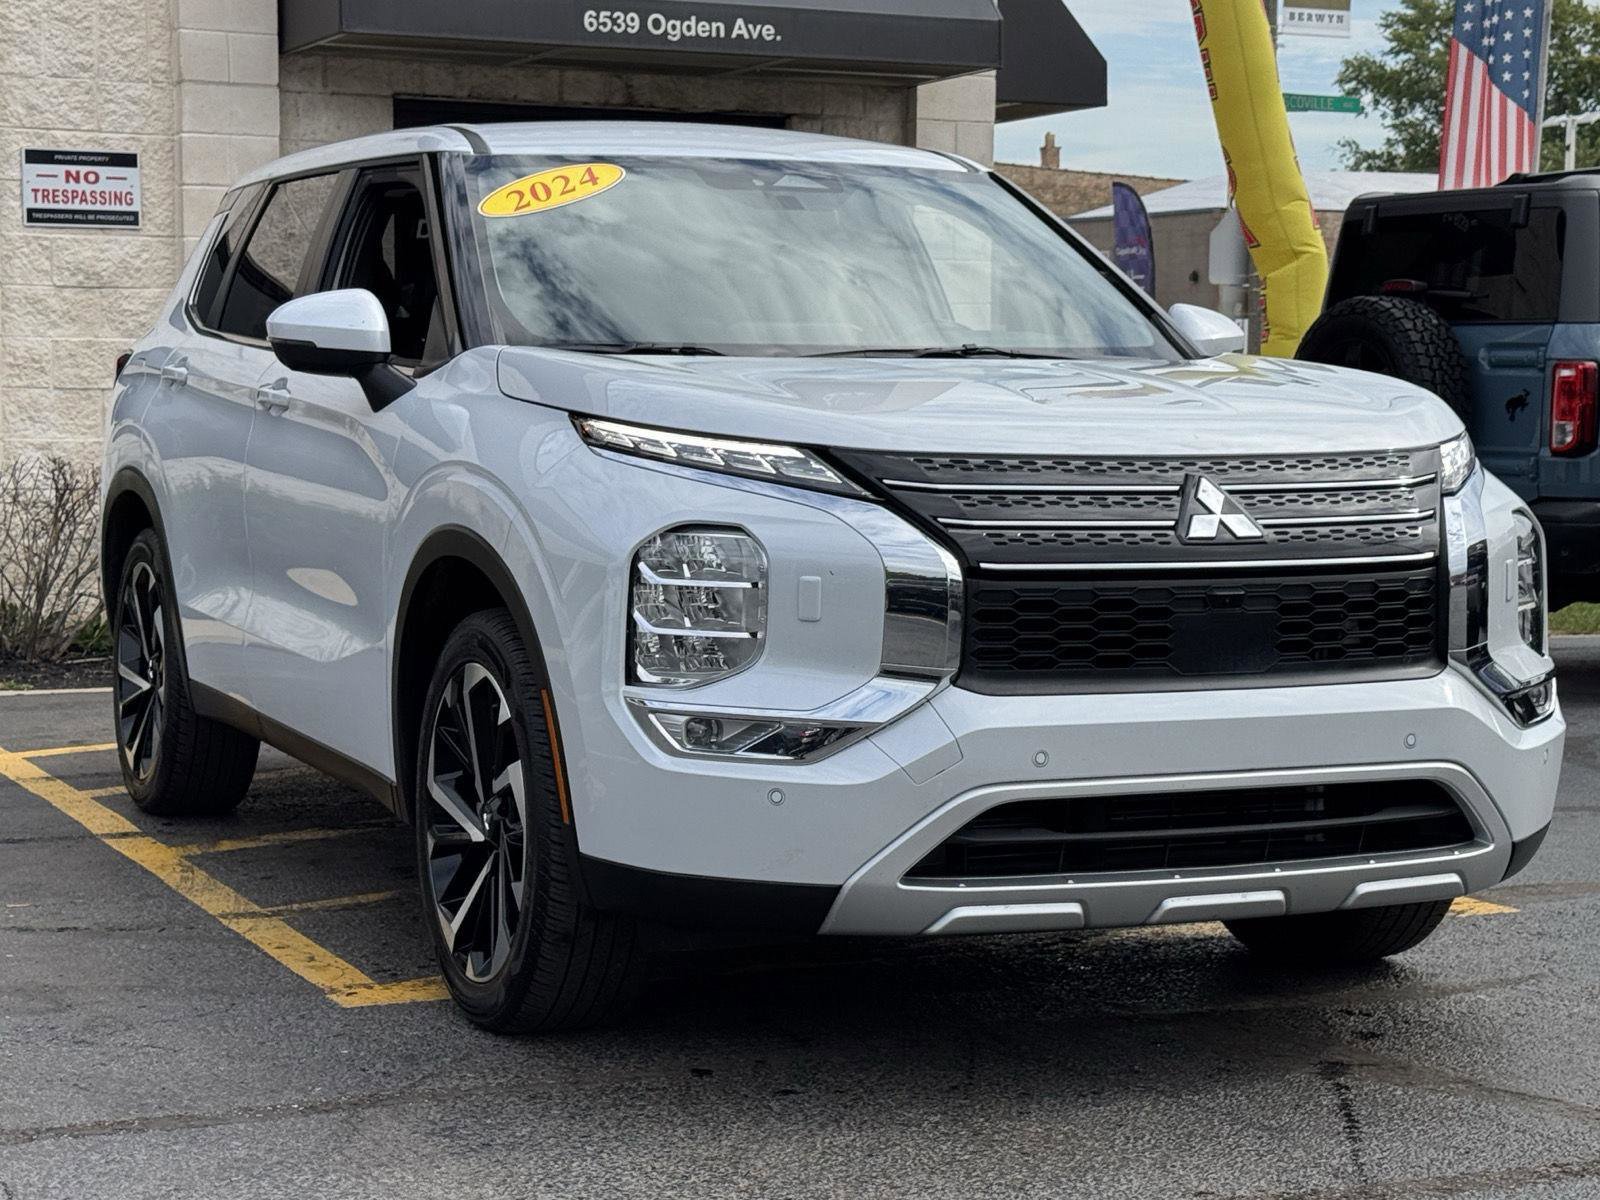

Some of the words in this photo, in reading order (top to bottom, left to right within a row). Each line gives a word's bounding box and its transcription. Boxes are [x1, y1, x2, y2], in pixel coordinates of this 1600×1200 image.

[583, 10, 640, 34] 6539
[647, 13, 725, 42] Ogden
[731, 18, 782, 41] Ave.
[1288, 11, 1344, 24] BERWYN
[64, 169, 100, 185] NO
[31, 188, 134, 206] TRESPASSING
[506, 166, 600, 212] 2024
[32, 212, 73, 220] TRESPASSERS
[74, 213, 87, 221] WILL
[96, 214, 135, 222] PROSECUTED
